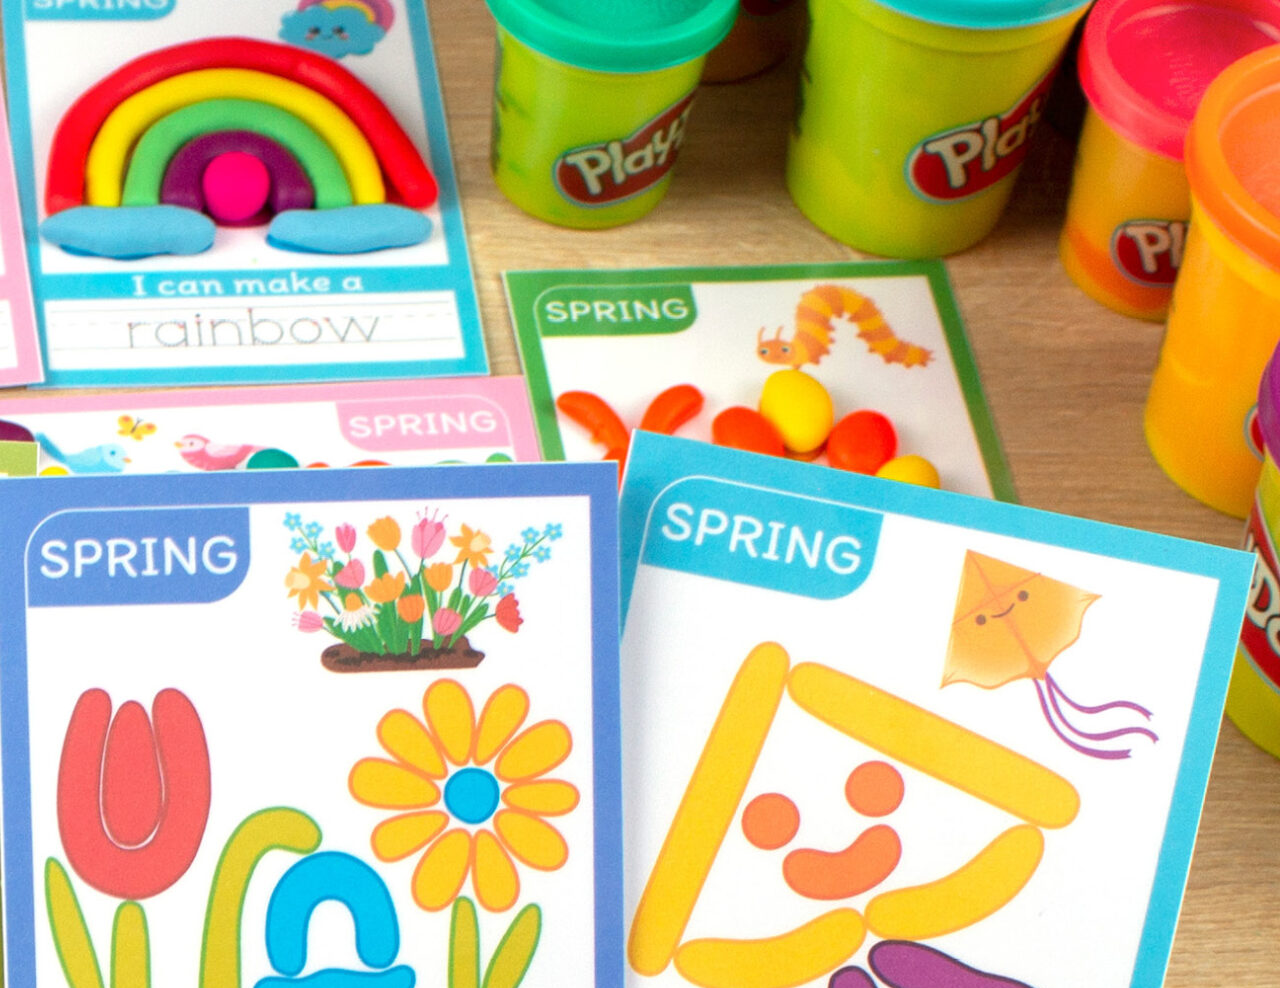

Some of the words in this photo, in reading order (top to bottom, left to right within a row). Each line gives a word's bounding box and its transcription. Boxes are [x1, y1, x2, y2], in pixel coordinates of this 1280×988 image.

[133, 276, 148, 296] I
[158, 276, 224, 297] can
[232, 270, 331, 295] make
[342, 275, 364, 292] a
[128, 308, 380, 348] rainbow
[545, 298, 689, 323] SPRING
[349, 409, 498, 439] SPRING
[40, 535, 238, 578] SPRING
[662, 502, 862, 576] SPRING
